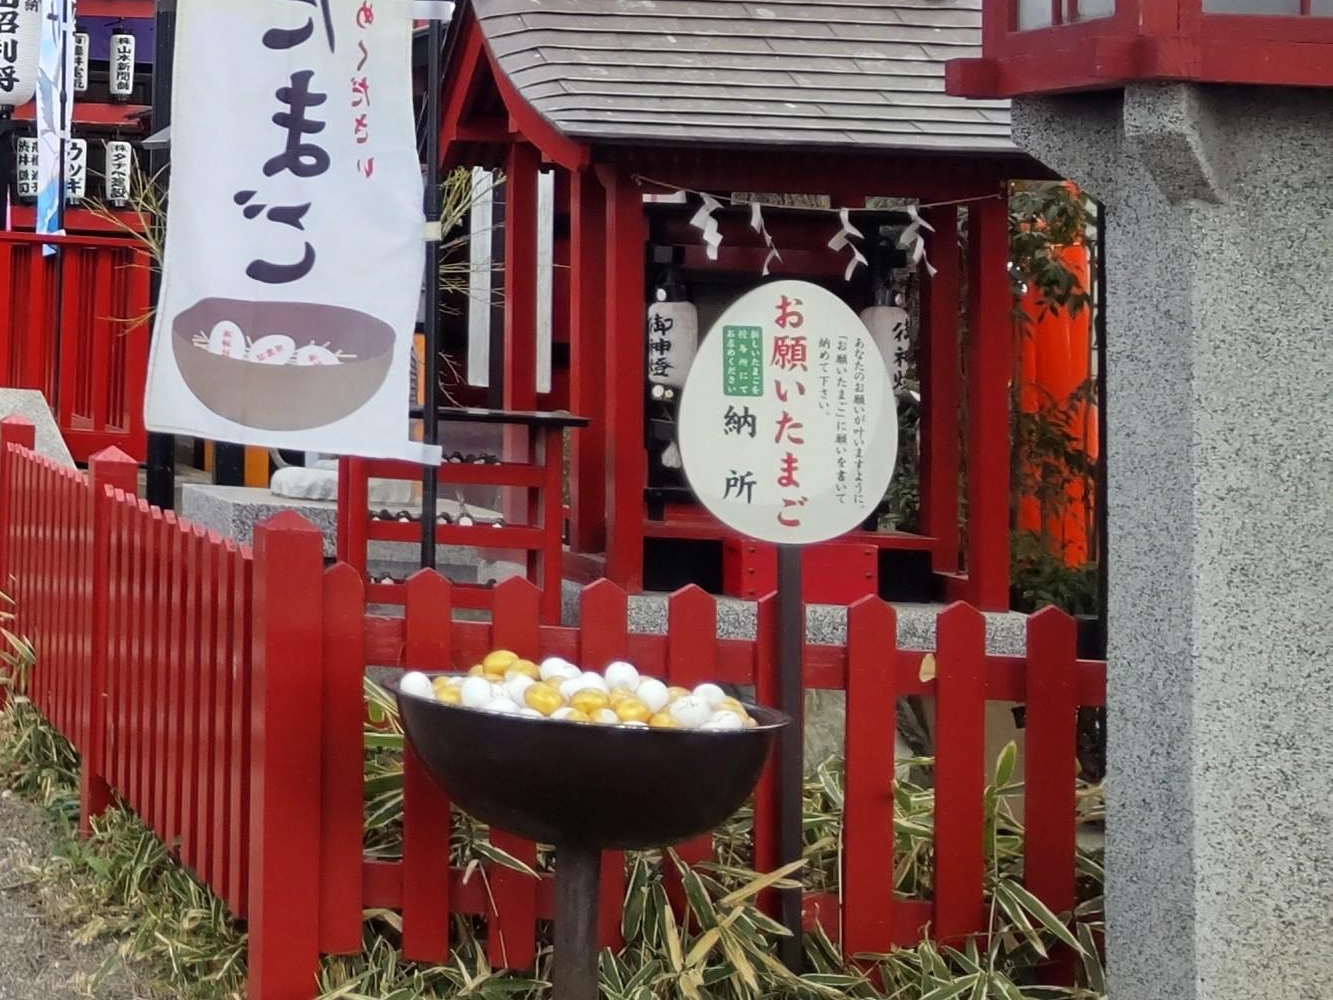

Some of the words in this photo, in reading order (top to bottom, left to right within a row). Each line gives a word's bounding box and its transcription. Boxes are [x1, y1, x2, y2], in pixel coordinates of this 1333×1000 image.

[723, 404, 758, 505] 納所
[769, 293, 809, 528] お願いたまご
[853, 337, 866, 510] あなたのお願いが叶いますように。
